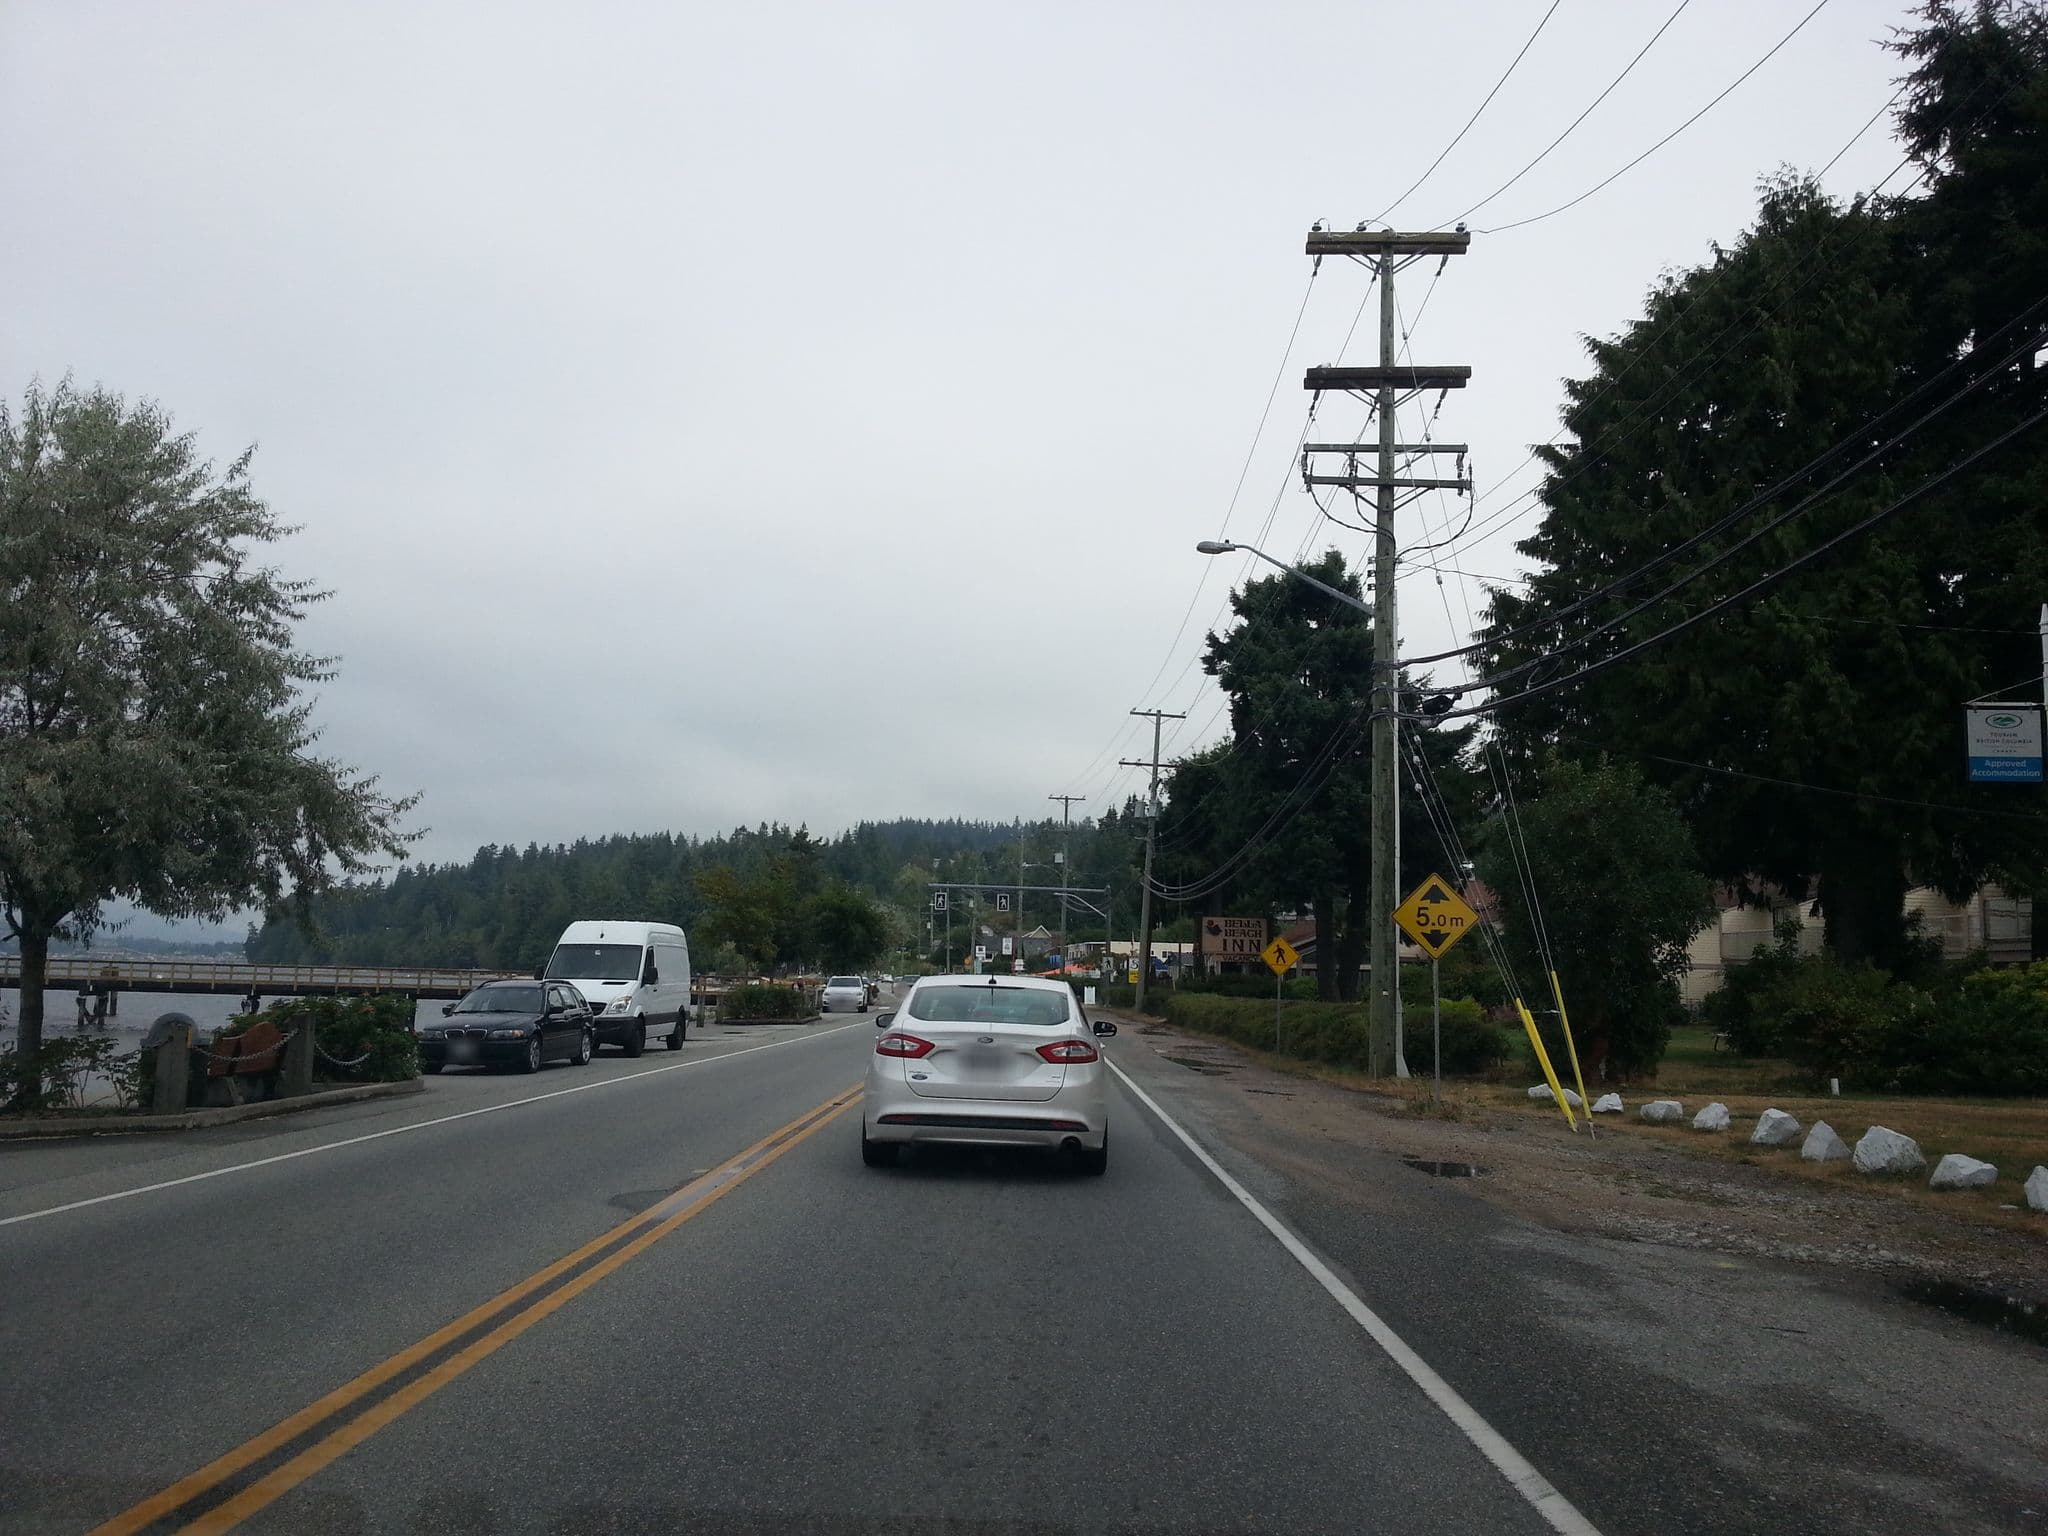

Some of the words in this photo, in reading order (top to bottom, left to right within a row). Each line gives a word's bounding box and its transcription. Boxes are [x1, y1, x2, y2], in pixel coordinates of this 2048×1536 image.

[1984, 760, 2026, 768] Approved
[1972, 769, 2040, 777] Accommodation
[1224, 920, 1262, 929] BELLA
[1224, 929, 1262, 938] BEACH
[1223, 939, 1261, 952] INN
